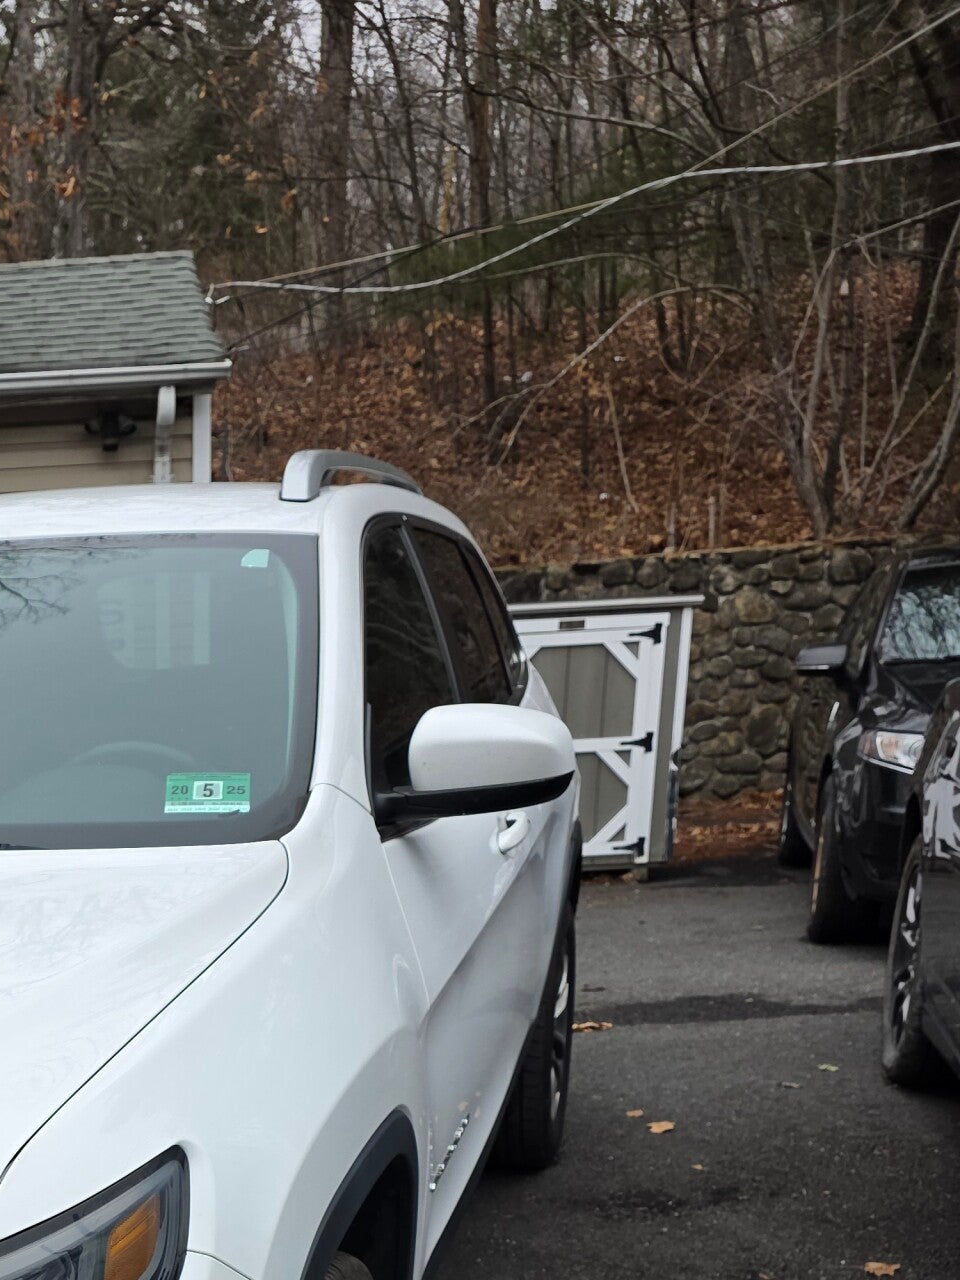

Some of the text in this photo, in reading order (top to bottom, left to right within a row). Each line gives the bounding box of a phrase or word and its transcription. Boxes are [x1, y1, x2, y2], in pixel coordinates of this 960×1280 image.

[171, 783, 246, 798] 20 5 25
